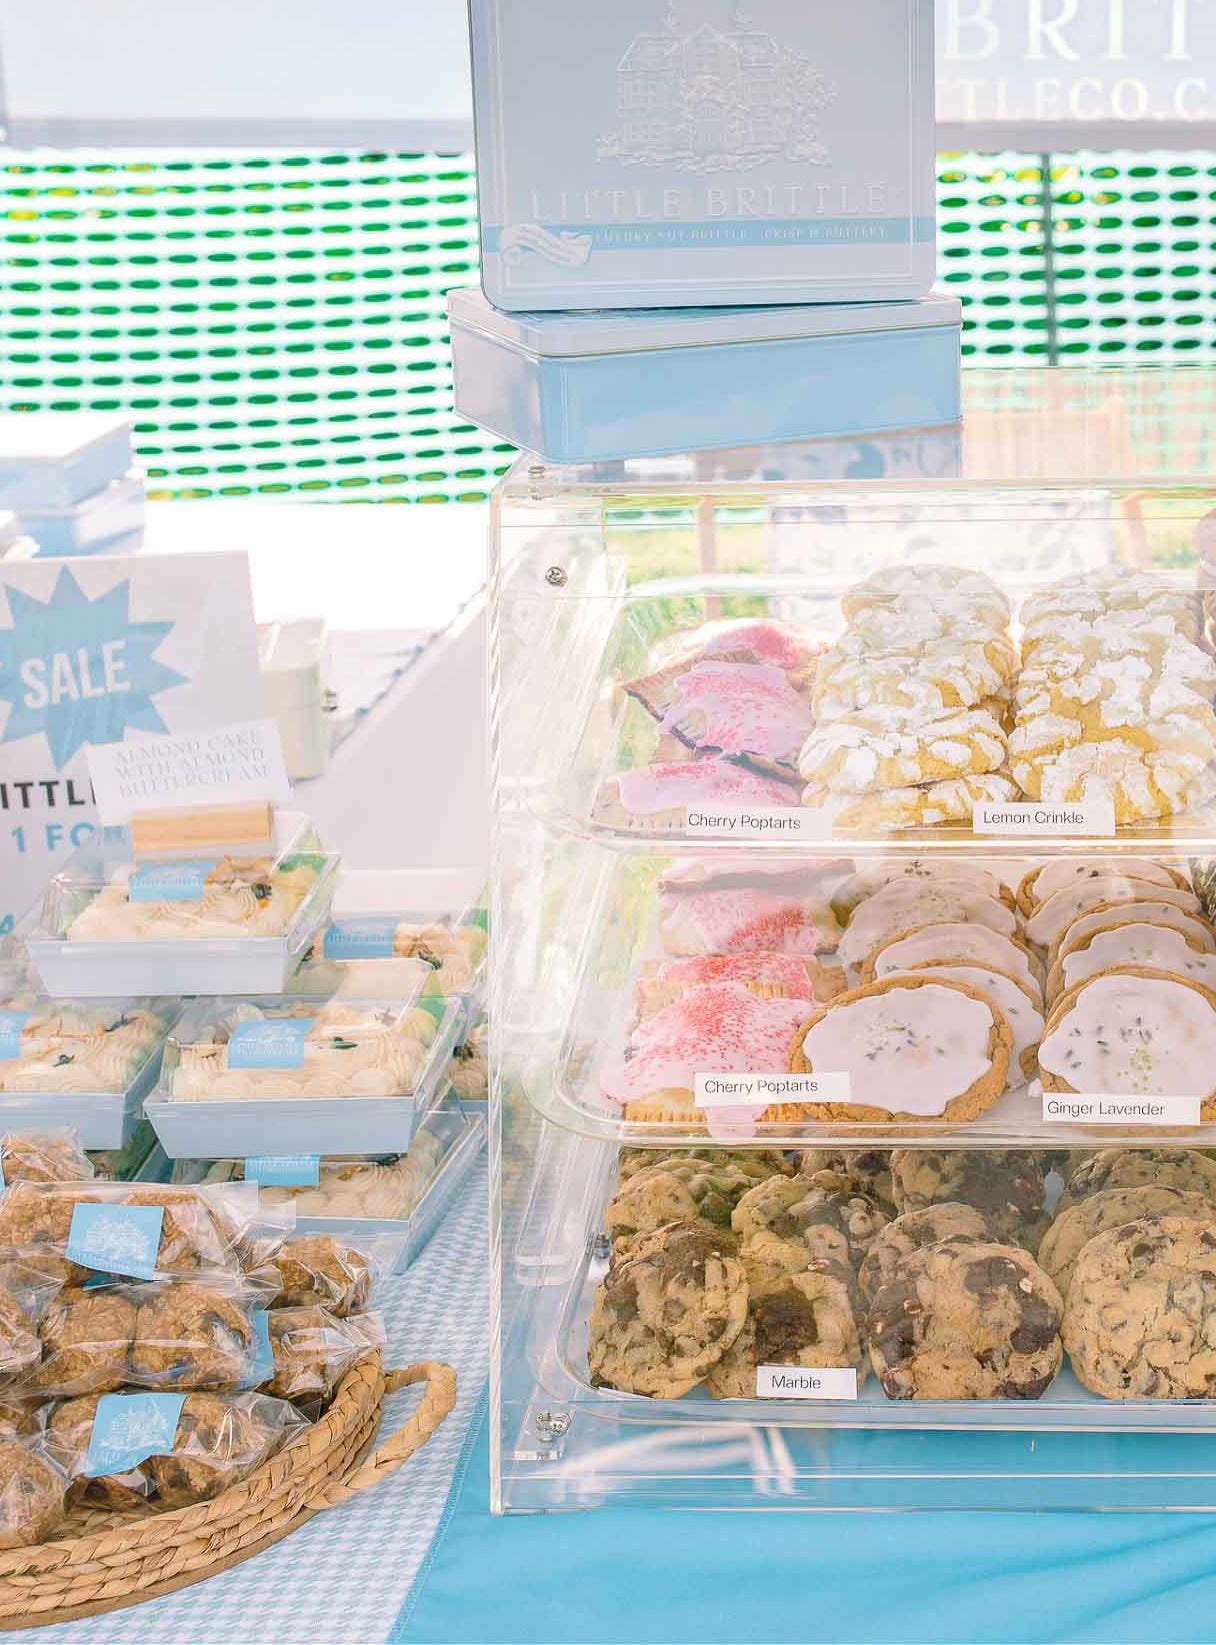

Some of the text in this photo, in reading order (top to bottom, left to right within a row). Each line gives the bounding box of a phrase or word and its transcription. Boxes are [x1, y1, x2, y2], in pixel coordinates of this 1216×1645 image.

[531, 181, 888, 221] LITTLE BRITTLE
[21, 640, 131, 709] SALE
[0, 777, 97, 810] ITTL
[688, 813, 801, 831] Cherry Poptarts
[983, 810, 1084, 826] Lemon Crinkle
[704, 1078, 818, 1097] Cherry Poptarts
[1047, 1100, 1166, 1118] Ginger Lavender
[771, 1374, 821, 1390] Marble
